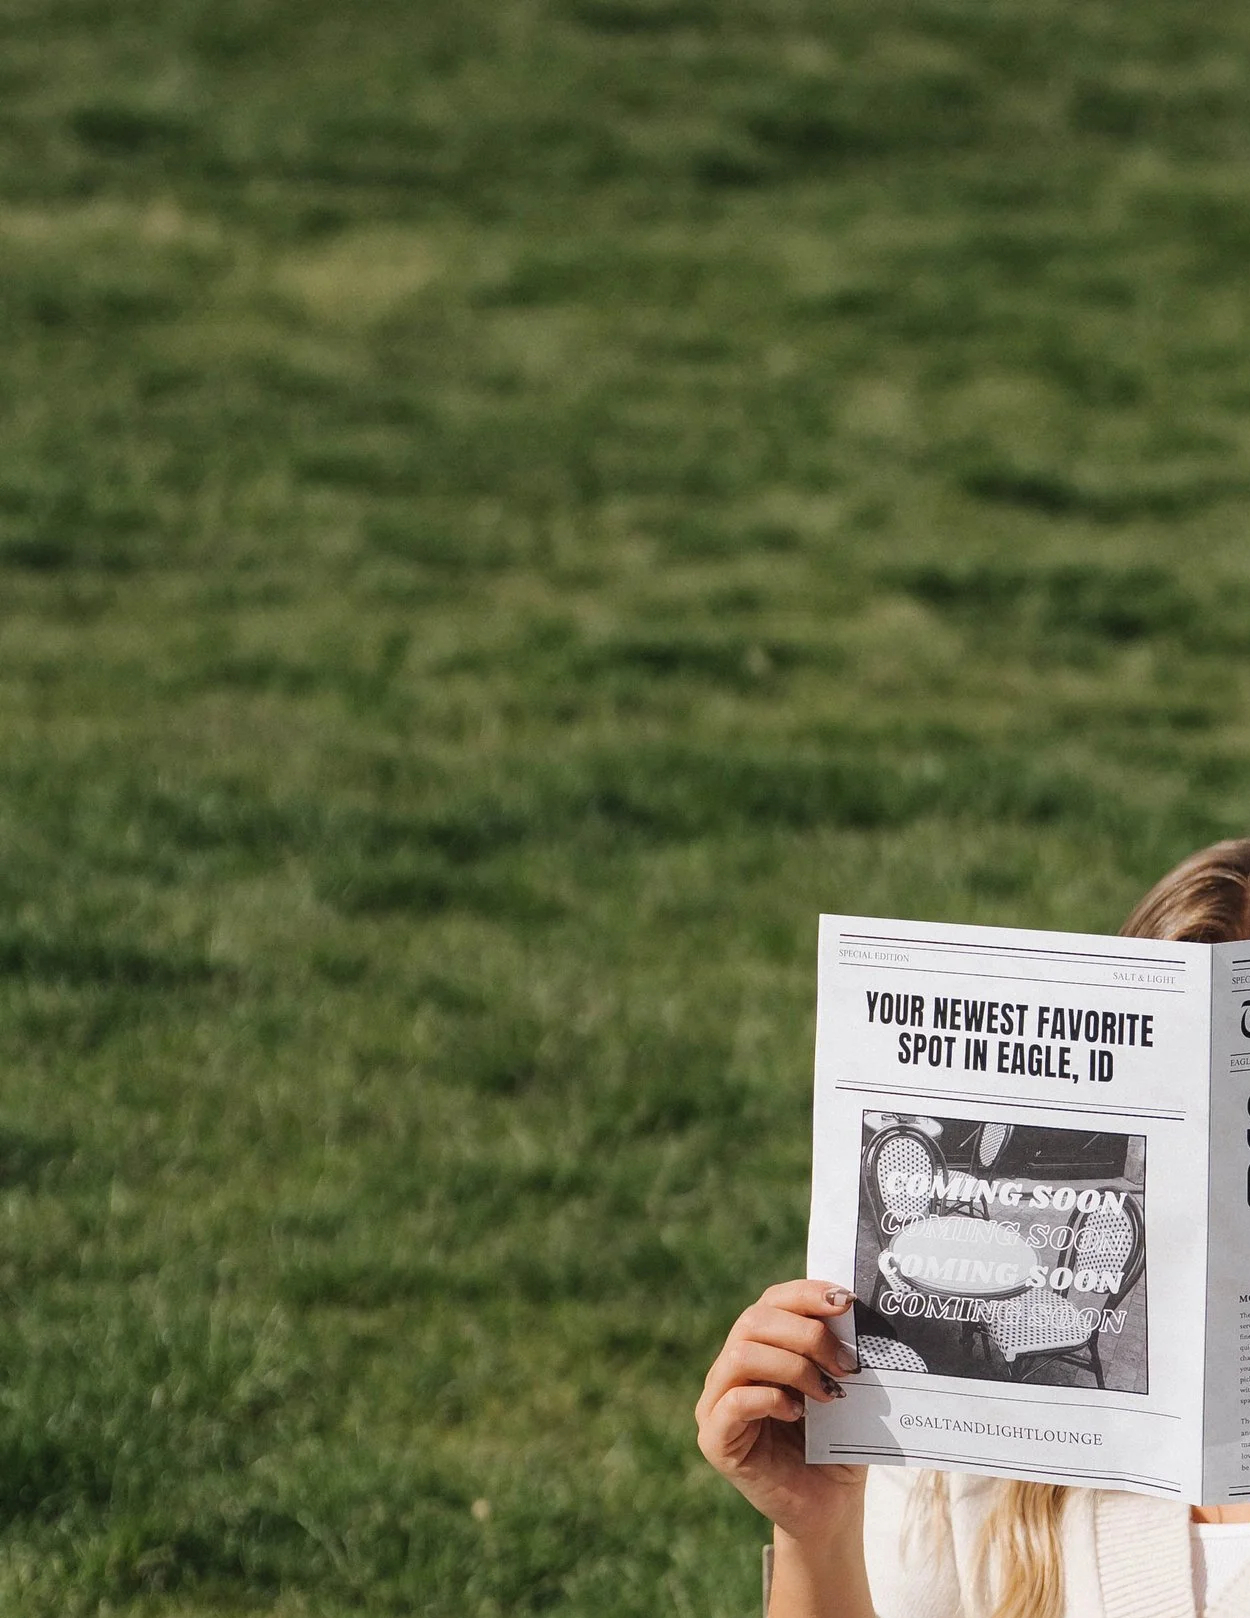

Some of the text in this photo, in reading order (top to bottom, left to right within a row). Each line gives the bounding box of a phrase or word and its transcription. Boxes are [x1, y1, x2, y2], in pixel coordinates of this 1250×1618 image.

[839, 949, 910, 963] SPECIAL EDITION
[1112, 972, 1136, 982] SALT
[1147, 975, 1176, 984] LIGHT
[866, 990, 1154, 1047] YOUR NEWEST FAVORITE
[898, 1032, 1114, 1084] SPOT IN EAGLE, ID
[886, 1172, 1127, 1216] COMING SOON
[881, 1211, 1126, 1255] COMING SOON
[880, 1251, 1124, 1295] COMING SOON
[879, 1291, 1127, 1334] COMING SOON
[899, 1413, 1103, 1446] @SALTANDLIGHTLOUNGE
